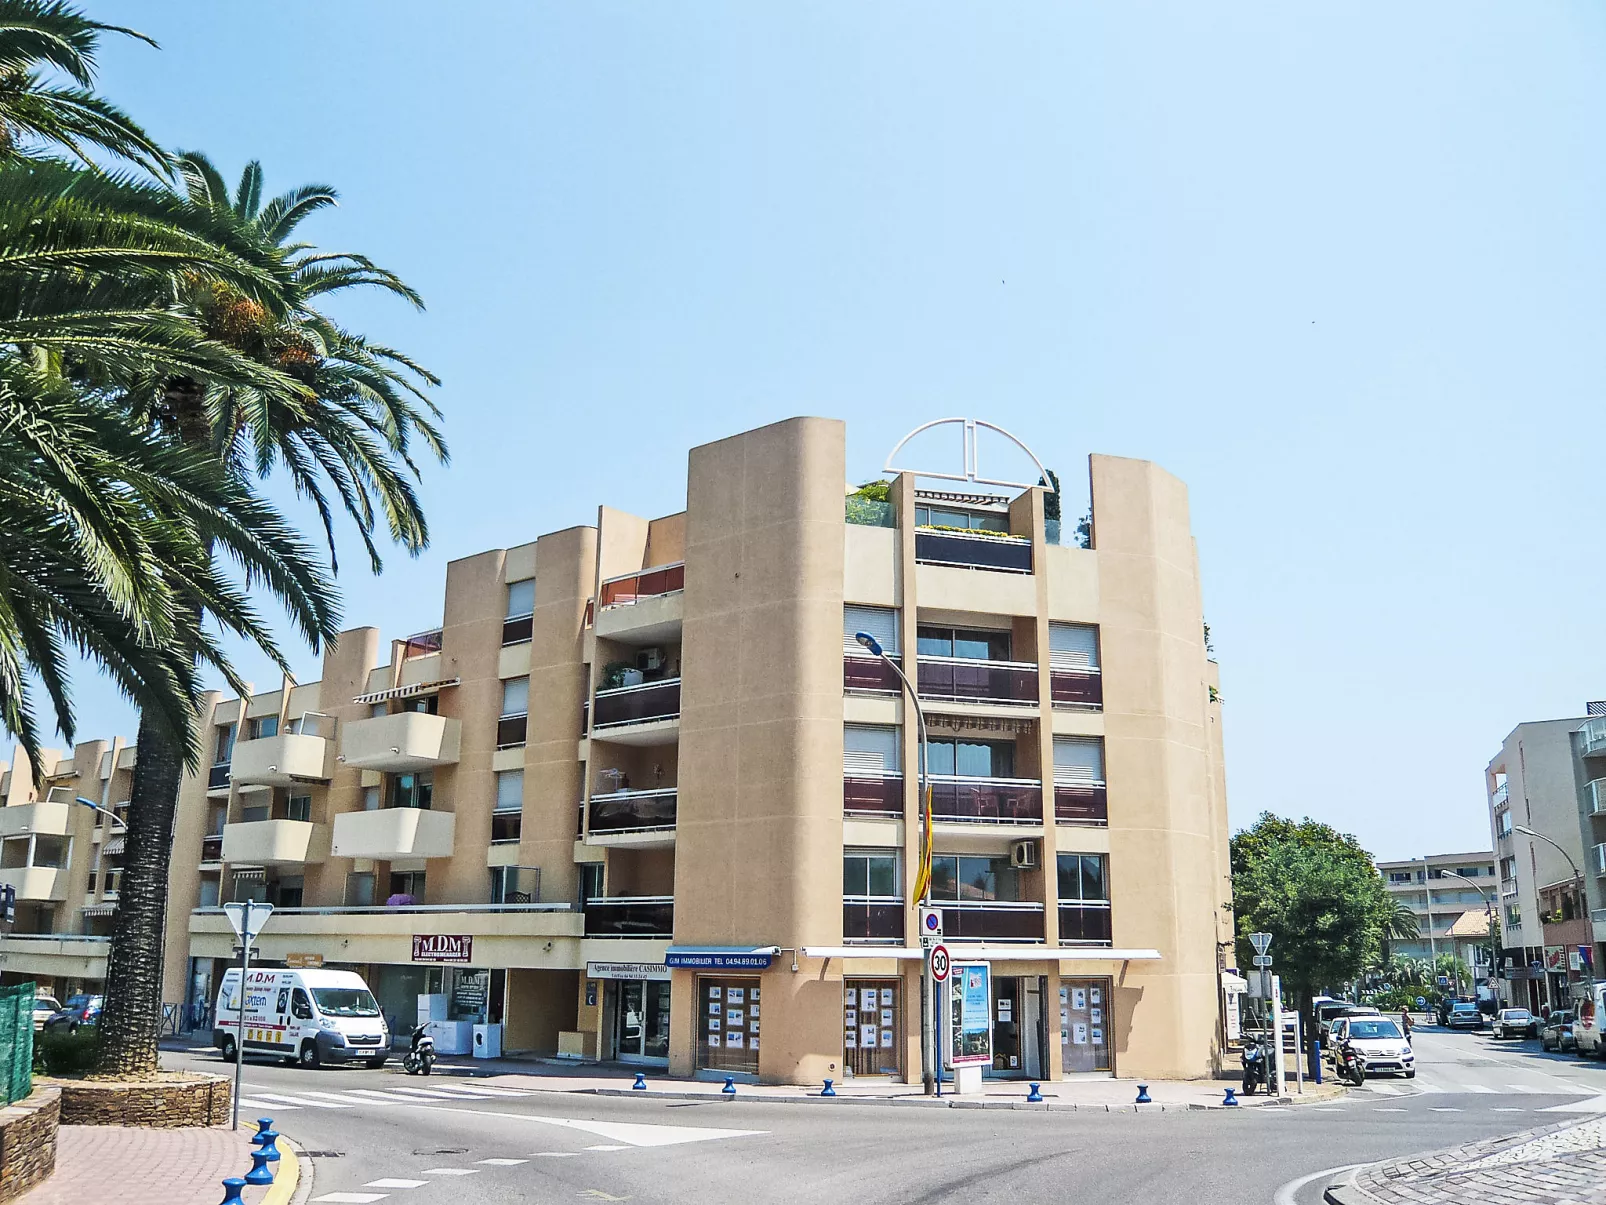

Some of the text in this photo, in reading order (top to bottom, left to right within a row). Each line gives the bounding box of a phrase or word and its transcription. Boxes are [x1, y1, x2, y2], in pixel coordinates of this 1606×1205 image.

[422, 935, 461, 952] M.D.M
[681, 957, 712, 965] IMMOBILIER
[934, 955, 946, 971] 30
